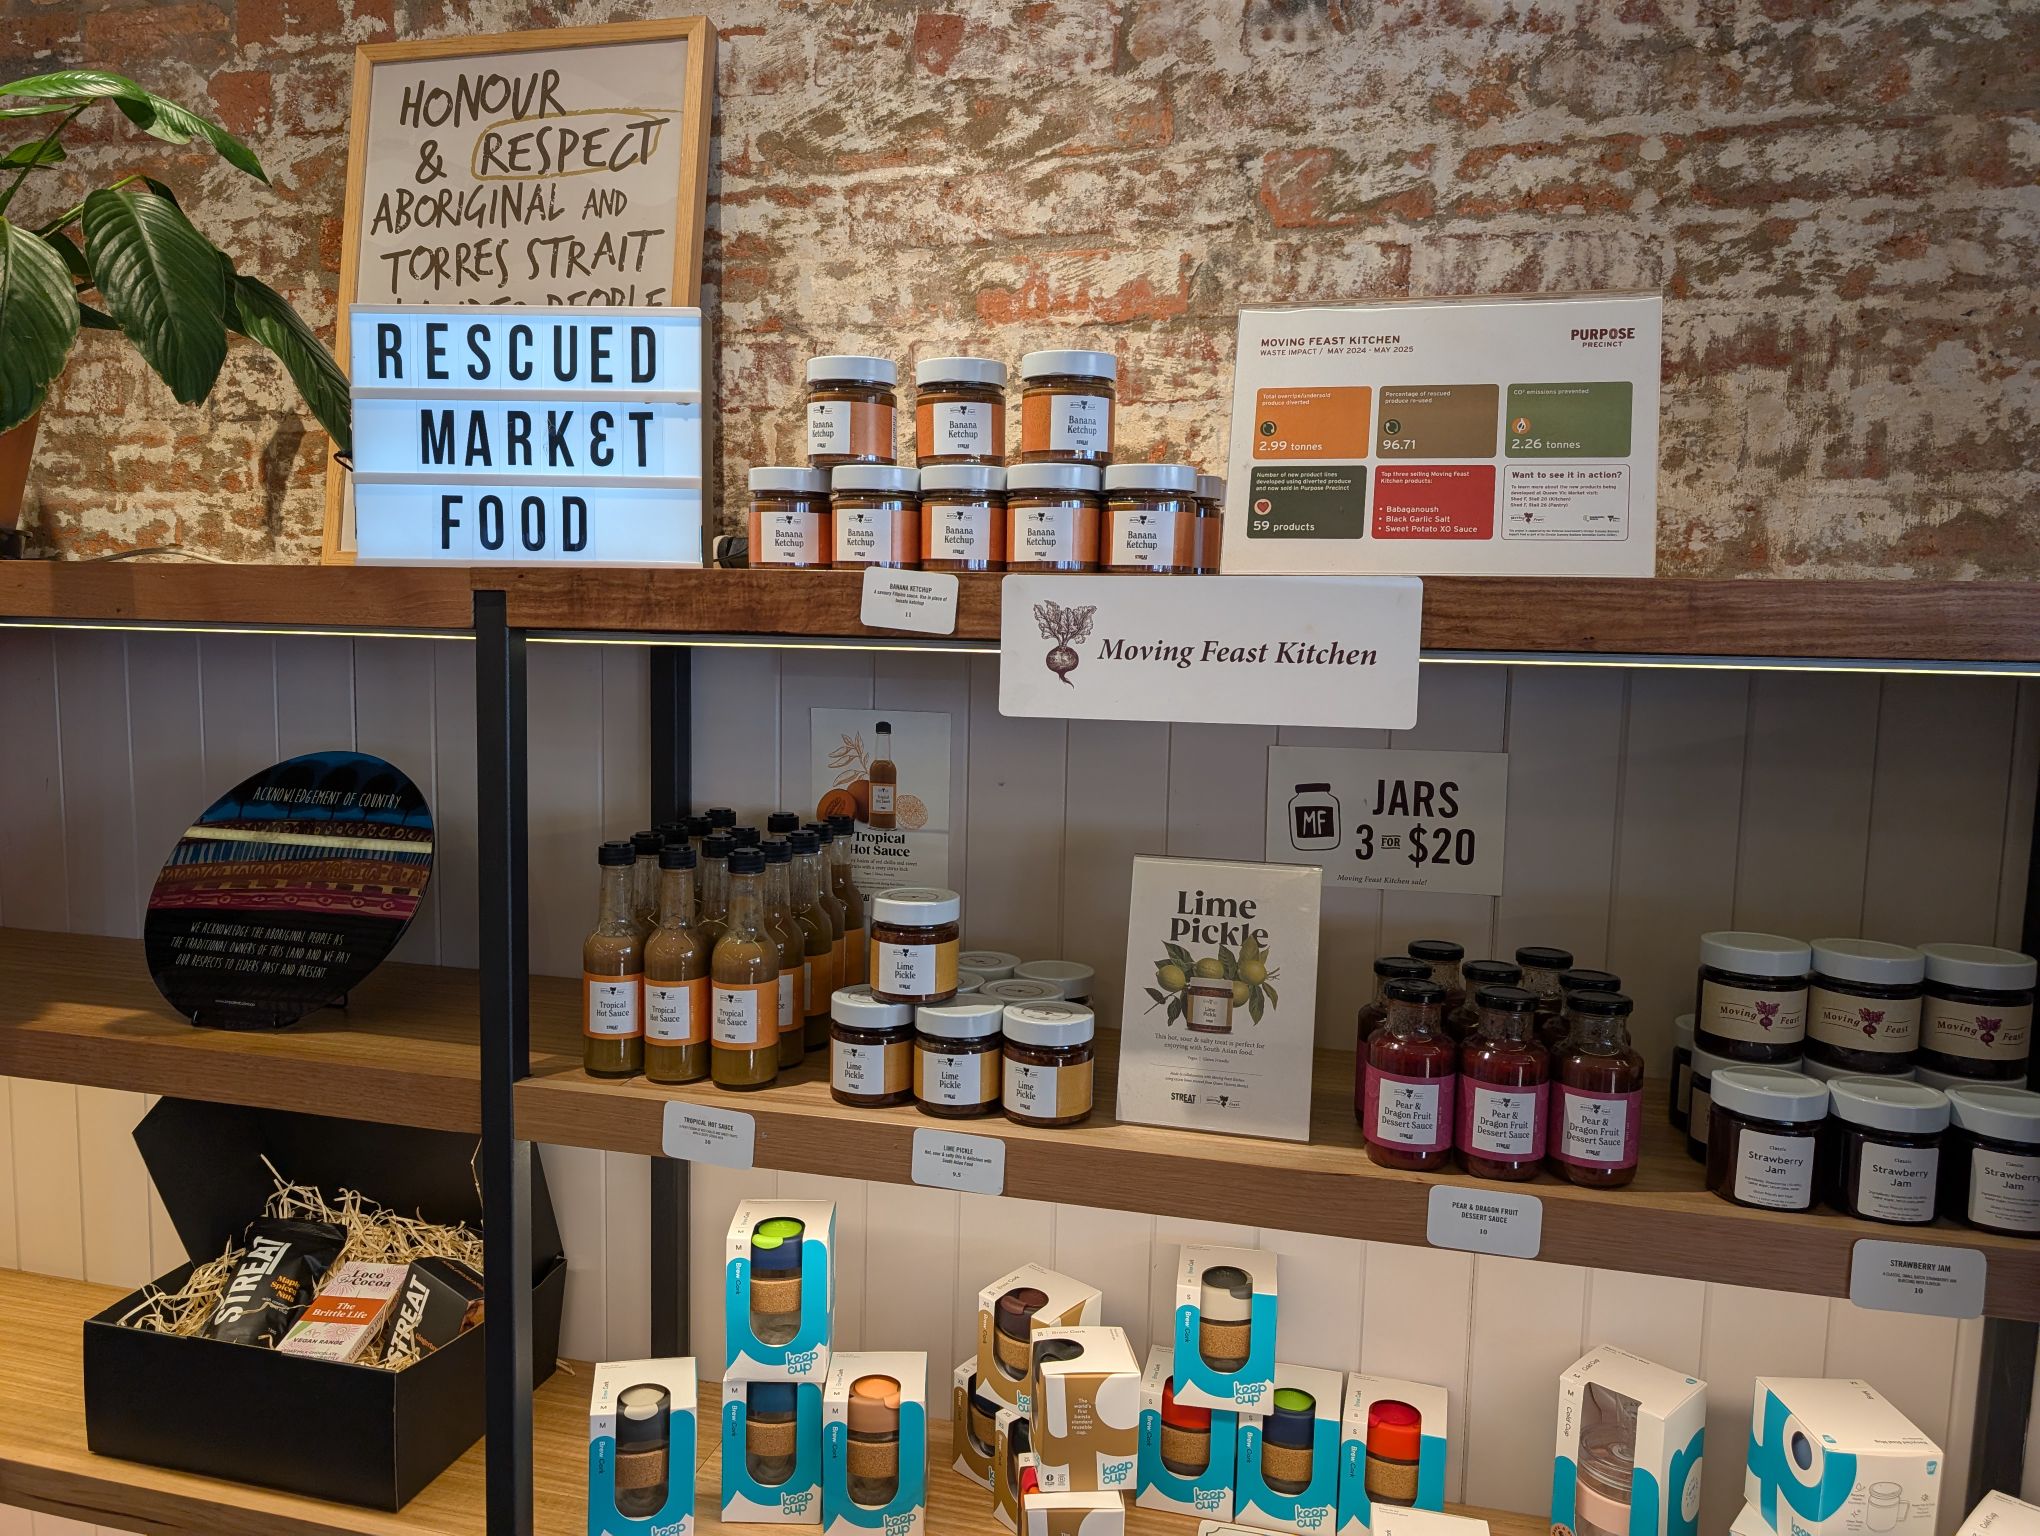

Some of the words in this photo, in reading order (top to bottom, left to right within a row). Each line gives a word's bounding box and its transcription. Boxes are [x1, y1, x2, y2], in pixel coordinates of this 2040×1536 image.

[400, 69, 566, 127] HONOUR
[415, 140, 447, 183] &
[481, 117, 670, 175] RESPECT
[371, 182, 565, 235] ABORIGINAL
[582, 188, 628, 220] AND
[380, 238, 508, 294] TORRES
[527, 229, 665, 281] STRAIT
[1261, 338, 1305, 347] MOVING
[1309, 337, 1345, 346] FEAST
[1349, 335, 1400, 344] KITCHEN
[1570, 327, 1635, 343] PURPOSE
[377, 323, 656, 383] RESCUED
[949, 419, 977, 430] Banana
[1069, 415, 1096, 426] Banana
[948, 429, 978, 439] Ketchup
[1067, 424, 1097, 435] Ketchup
[421, 409, 654, 467] MARKET
[1512, 439, 1542, 449] 2.26
[1547, 440, 1580, 449] tonnes
[1259, 441, 1287, 451] 2.99
[1291, 443, 1322, 451] tonnes
[1383, 440, 1416, 450] 96.71
[1386, 506, 1439, 514] Babaganoush
[441, 495, 587, 551] FOOD
[1386, 515, 1408, 523] Black
[1410, 515, 1433, 523] Garlic
[1435, 515, 1450, 523] Salt
[945, 526, 973, 536] Banana
[1254, 521, 1269, 530] 59
[1274, 523, 1315, 532] products
[1385, 525, 1409, 533] Sweet
[1412, 525, 1437, 533] Potato
[1440, 525, 1451, 533] XO
[1454, 525, 1477, 533] Sauce
[1027, 528, 1056, 538] Banana
[1128, 531, 1157, 539] Banana
[944, 534, 974, 545] Ketchup
[1026, 536, 1057, 548] Ketchup
[1127, 540, 1157, 550] Ketchup
[890, 583, 908, 591] BANANA
[910, 585, 932, 593] KETCHUP
[1097, 637, 1193, 668] Moving
[1200, 638, 1269, 665] Feast
[1274, 640, 1378, 666] Kitchen
[253, 786, 340, 806] ACKNOWLEDGEMENT
[343, 792, 357, 806] OF
[359, 793, 402, 809] COUNTRY
[1373, 779, 1459, 818] JARS
[1303, 810, 1327, 836] MF
[854, 832, 905, 844] Tropical
[851, 844, 871, 855] Hot
[874, 846, 910, 857] Sauce
[1355, 824, 1374, 860] 3
[1381, 836, 1401, 847] FOR
[1408, 823, 1475, 868] $20
[1337, 874, 1363, 884] Moving
[1364, 875, 1382, 884] Feast
[1384, 876, 1410, 885] Kitchen
[1411, 878, 1427, 886] sale!
[1177, 890, 1257, 919] Lime
[1170, 917, 1269, 948] Pickle
[896, 962, 914, 971] Lime
[894, 970, 916, 980] Pickle
[600, 1001, 626, 1010] Tropical
[596, 1009, 607, 1017] Hot
[609, 1008, 630, 1017] Sauce
[1720, 1005, 1757, 1022] Moving
[1780, 1015, 1801, 1026] Feast
[1164, 1043, 1188, 1051] enjoying
[1203, 1045, 1220, 1053] South
[1235, 1040, 1255, 1048] perfect
[942, 1072, 959, 1081] Lime
[939, 1080, 961, 1090] Pickle
[1171, 1092, 1196, 1104] STREAT
[1492, 1109, 1510, 1120] Pear
[1512, 1111, 1519, 1120] &
[684, 1117, 707, 1126] TROPICAL
[1480, 1116, 1508, 1130] Dragon
[1510, 1120, 1529, 1130] Fruit
[1477, 1125, 1506, 1138] Dessert
[1508, 1129, 1529, 1140] Sauce
[956, 1147, 973, 1155] PICKLE
[1748, 1150, 1804, 1167] Strawberry
[1765, 1165, 1786, 1176] Jam
[1452, 1201, 1467, 1211] PEAR
[1469, 1204, 1474, 1212] &
[1475, 1204, 1499, 1214] DRAGON
[1501, 1207, 1518, 1216] FRUIT
[1461, 1211, 1487, 1222] DESSERT
[1488, 1214, 1508, 1224] SAUCE
[1890, 1259, 1936, 1272] STRAWBERRY
[1938, 1265, 1951, 1273] JAM
[214, 1235, 293, 1326] STREAT
[351, 1270, 384, 1279] Loco
[351, 1277, 391, 1288] Cocoa
[312, 1308, 346, 1319] Brittle
[347, 1311, 367, 1319] Life
[293, 1337, 318, 1345] VEGAN
[786, 1350, 818, 1366] keep
[787, 1360, 812, 1375] cup
[1234, 1381, 1267, 1397] keep
[1235, 1392, 1260, 1407] cup
[1564, 1423, 1572, 1437] Cup
[1103, 1461, 1133, 1476] keep
[1103, 1473, 1127, 1485] cup
[1194, 1488, 1226, 1503] keep
[1195, 1498, 1220, 1512] cup
